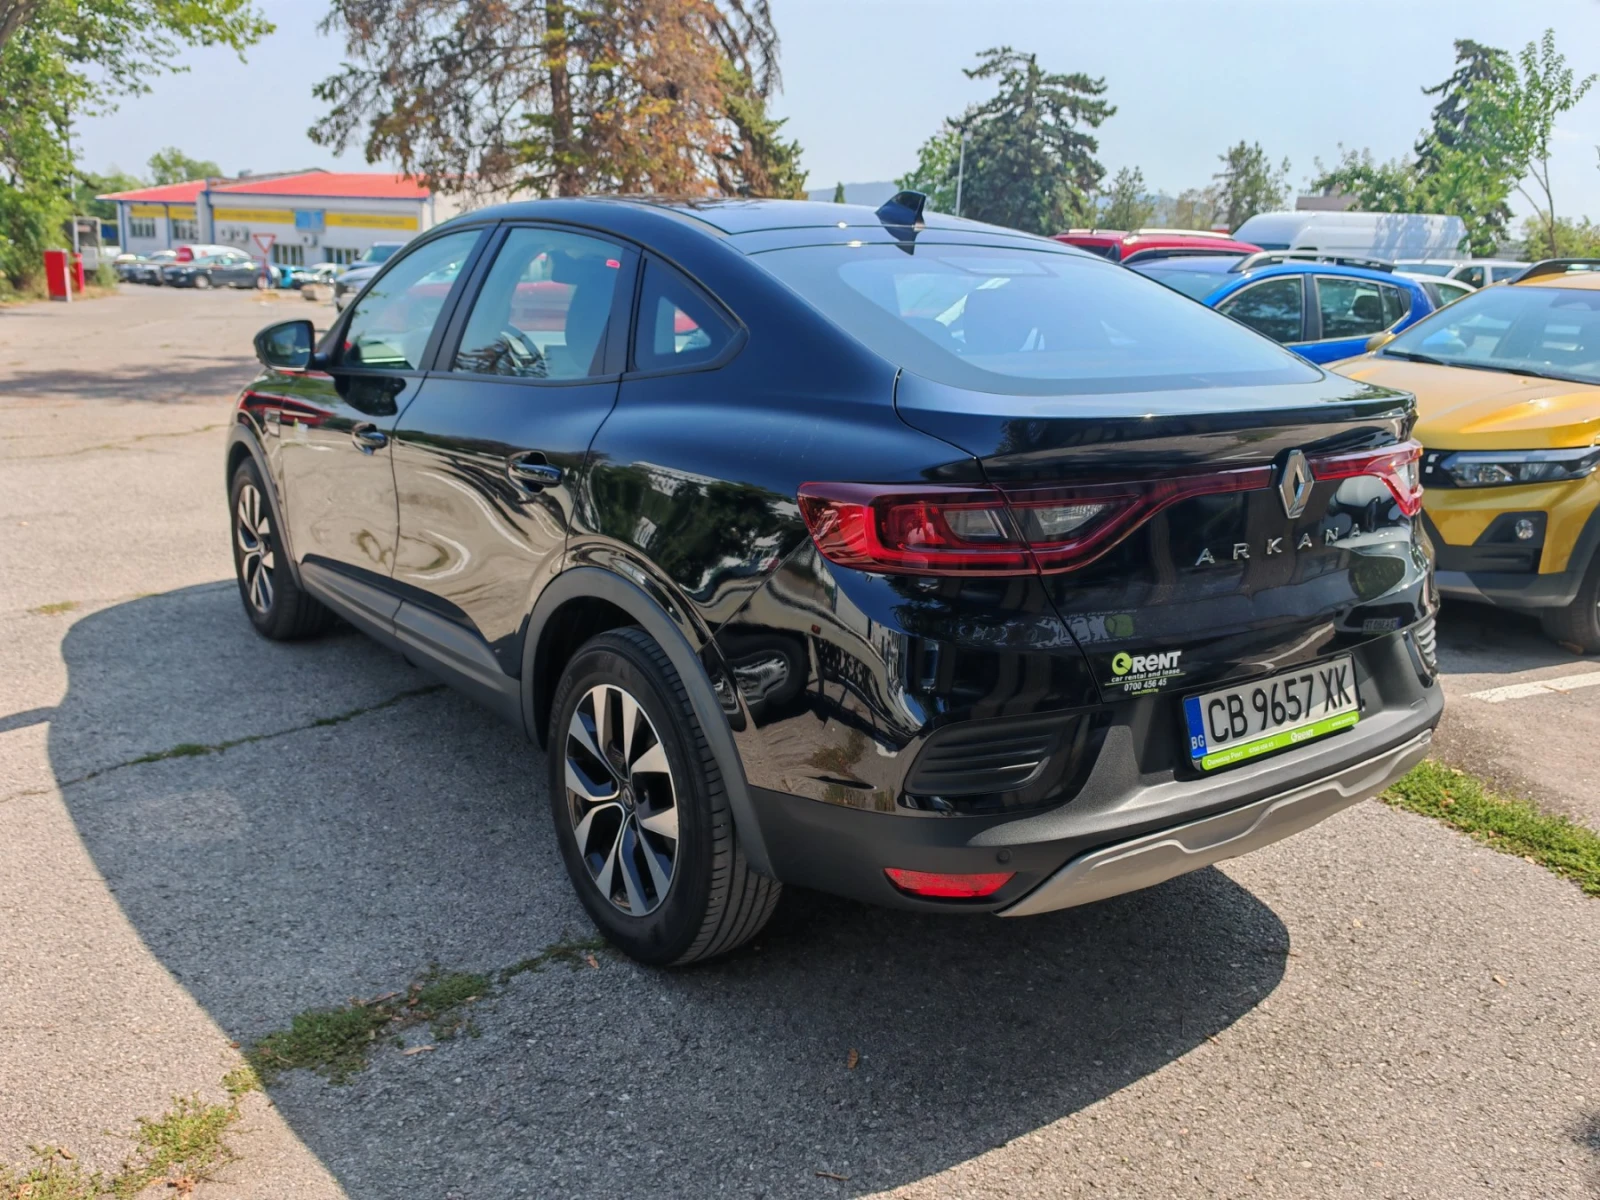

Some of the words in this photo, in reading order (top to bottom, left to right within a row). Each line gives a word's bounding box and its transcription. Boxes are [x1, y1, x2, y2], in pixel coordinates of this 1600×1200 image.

[1195, 523, 1361, 566] ARKANA
[1124, 683, 1142, 691] 0700
[1143, 680, 1157, 689] 456
[1158, 678, 1167, 686] 45
[1125, 673, 1147, 681] rental
[1207, 694, 1248, 743] CB
[1252, 674, 1314, 731] 9657
[1320, 664, 1352, 712] XK
[1191, 735, 1205, 750] BG
